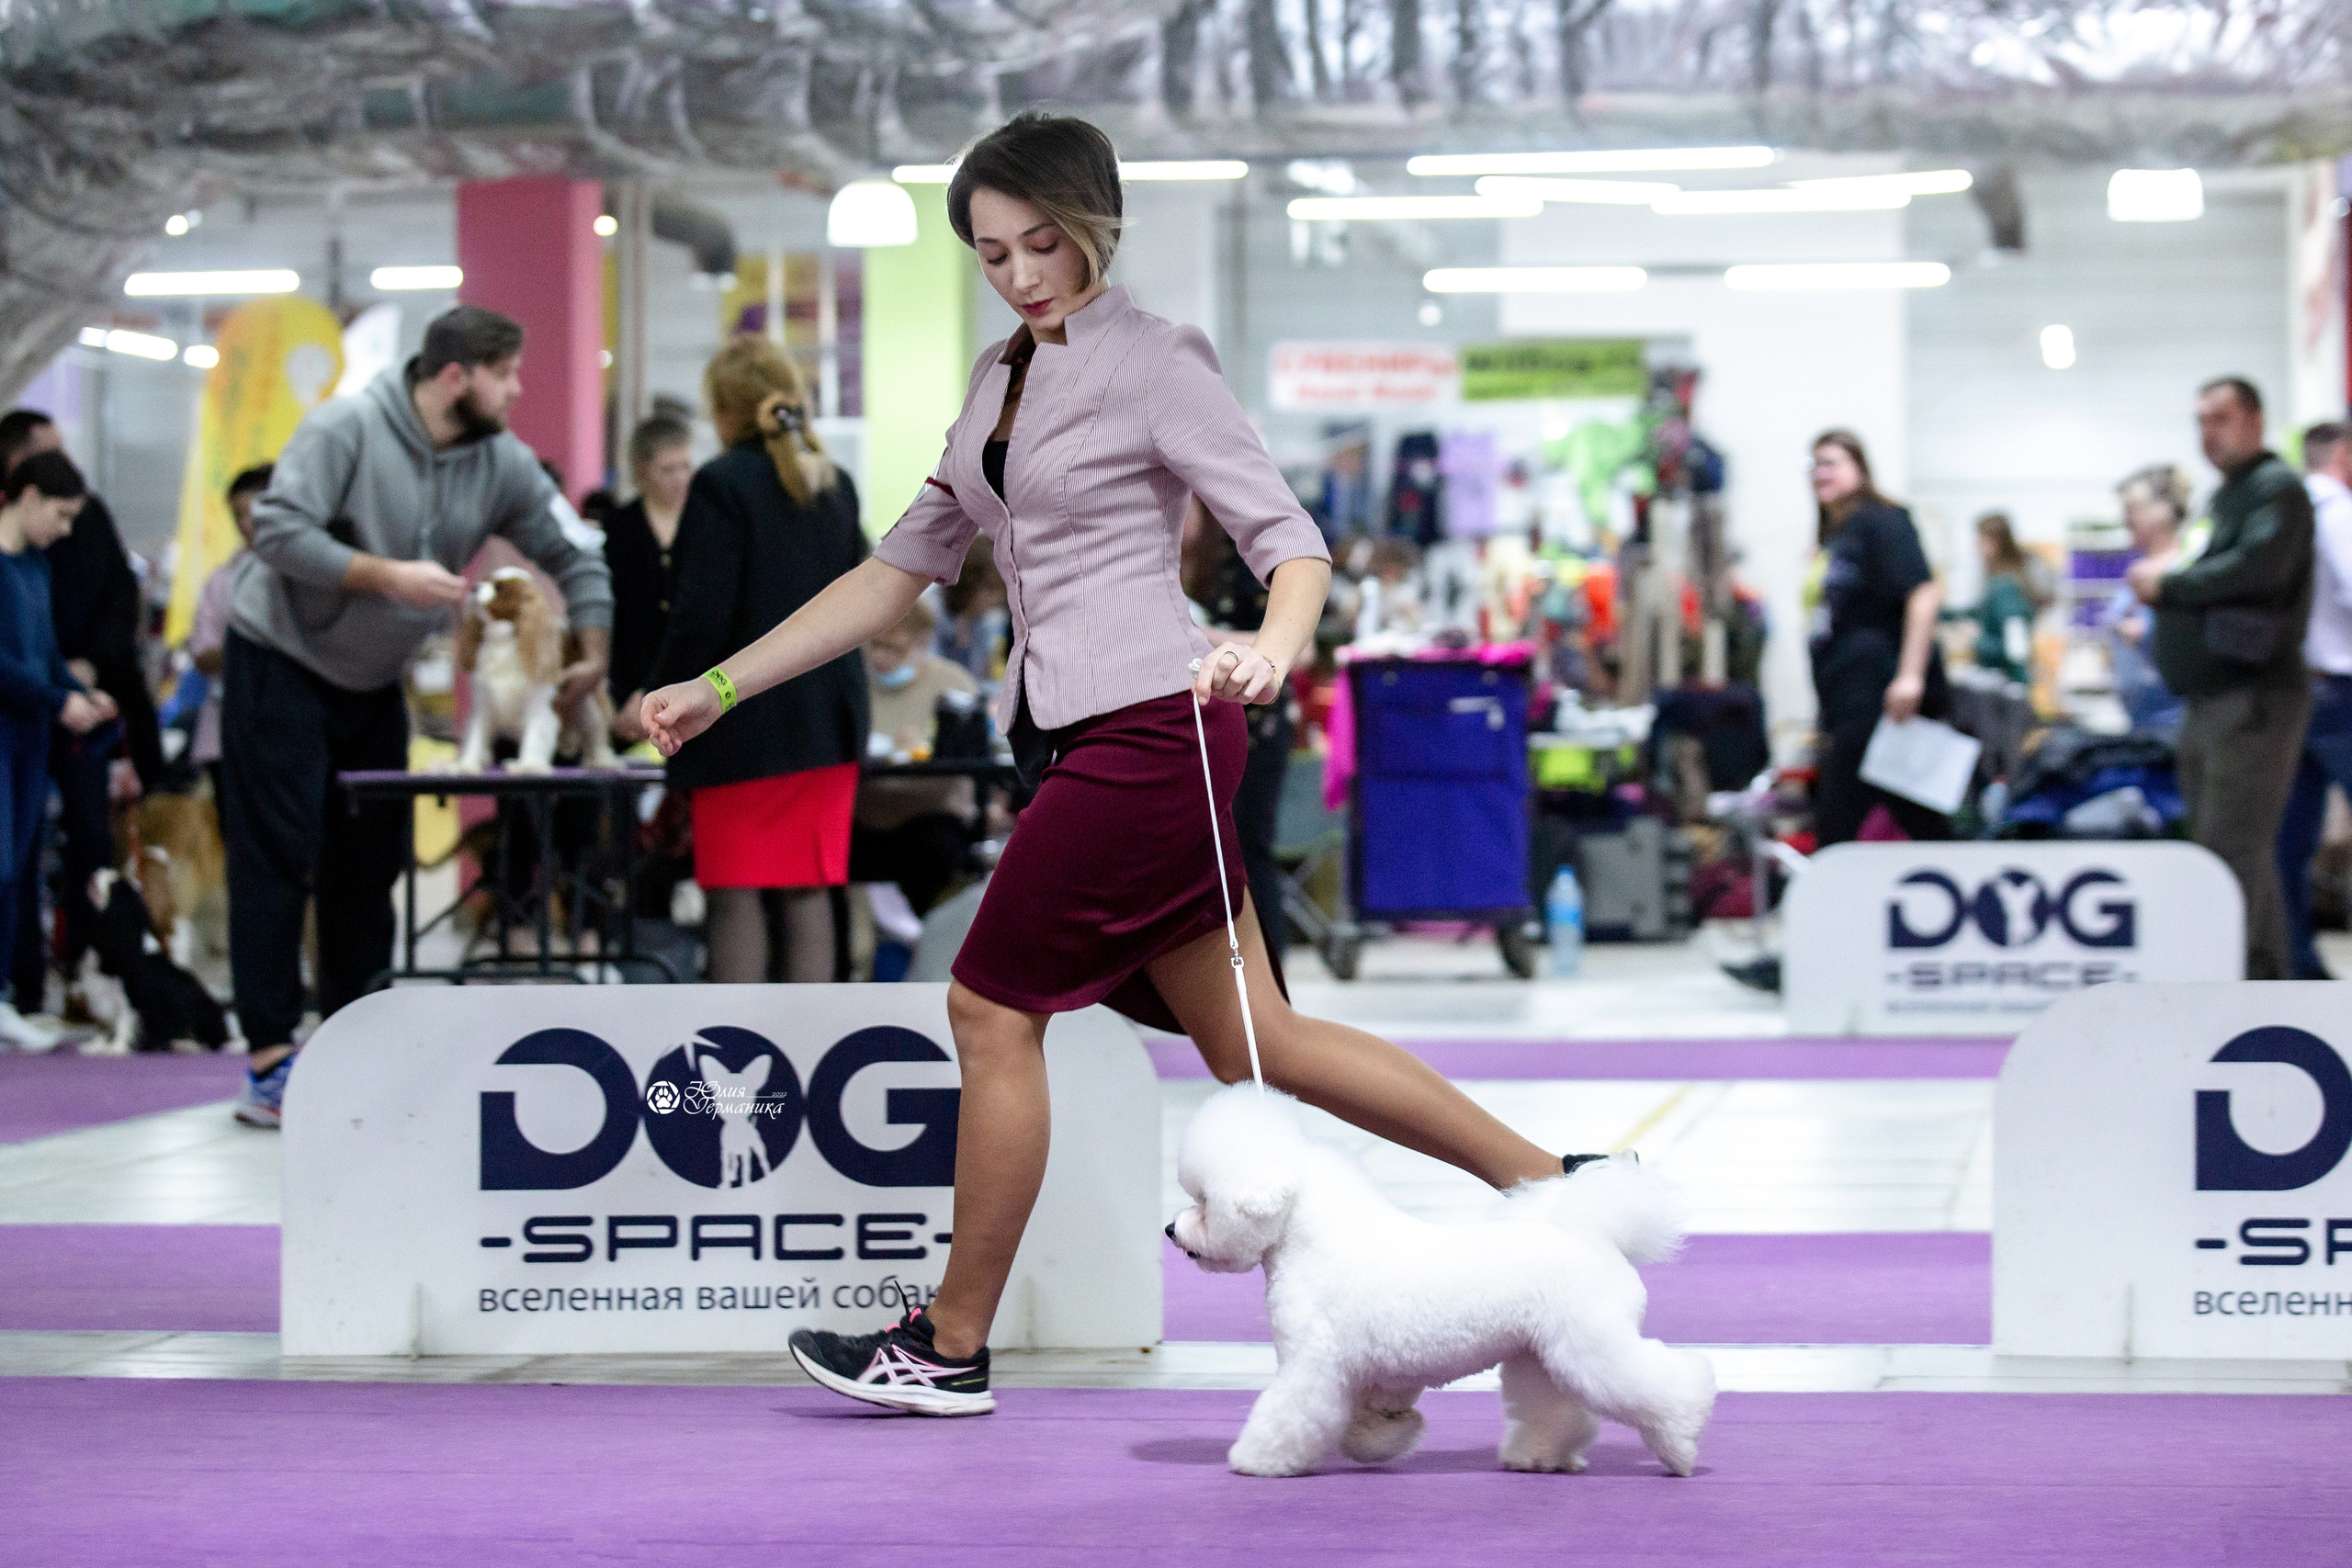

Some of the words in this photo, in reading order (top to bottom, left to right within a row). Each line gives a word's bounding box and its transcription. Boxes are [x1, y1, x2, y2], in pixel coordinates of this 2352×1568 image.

[1887, 869, 2137, 950] DOG
[480, 1025, 961, 1191] DOG
[479, 1286, 684, 1313] вселенная
[697, 1277, 820, 1311] вашей
